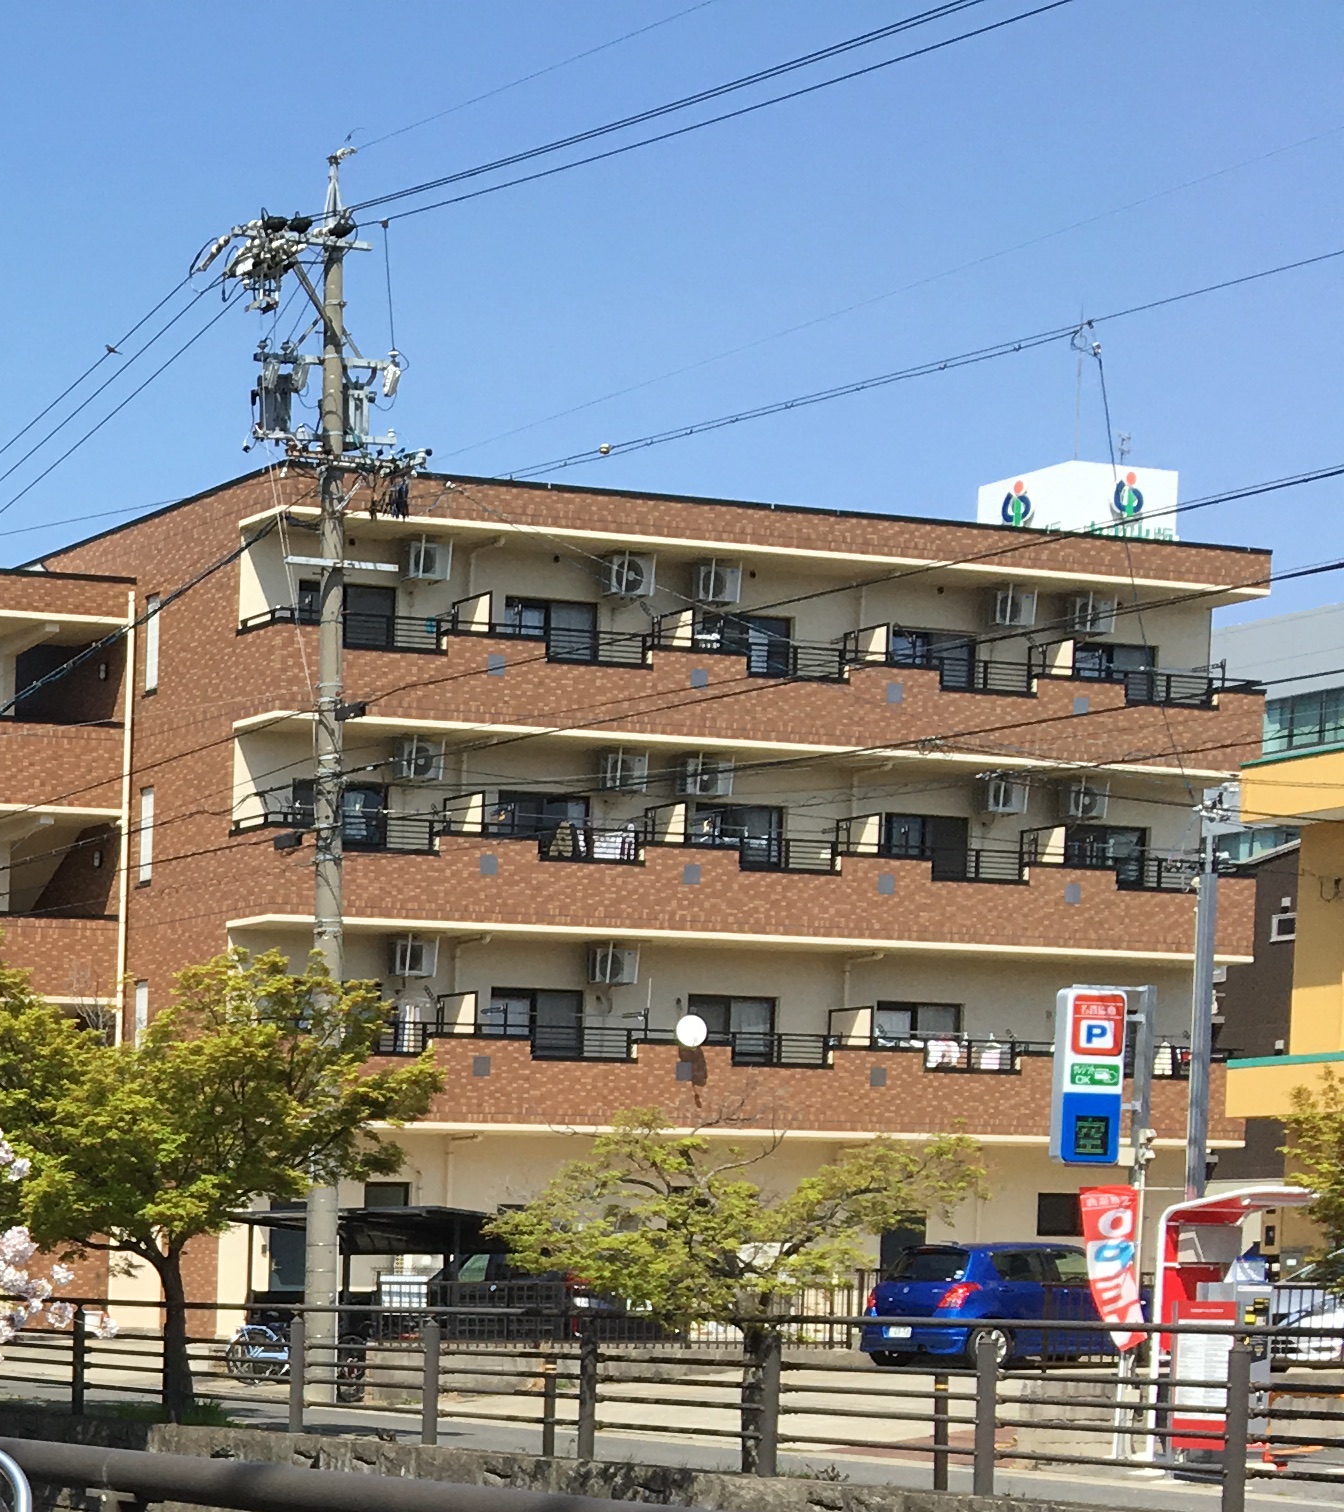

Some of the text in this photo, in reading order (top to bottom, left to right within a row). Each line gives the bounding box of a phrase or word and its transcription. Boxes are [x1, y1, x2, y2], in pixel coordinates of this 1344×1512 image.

[1085, 1024, 1108, 1044] P
[1075, 1075, 1091, 1084] OK
[1074, 1118, 1106, 1154] 空
